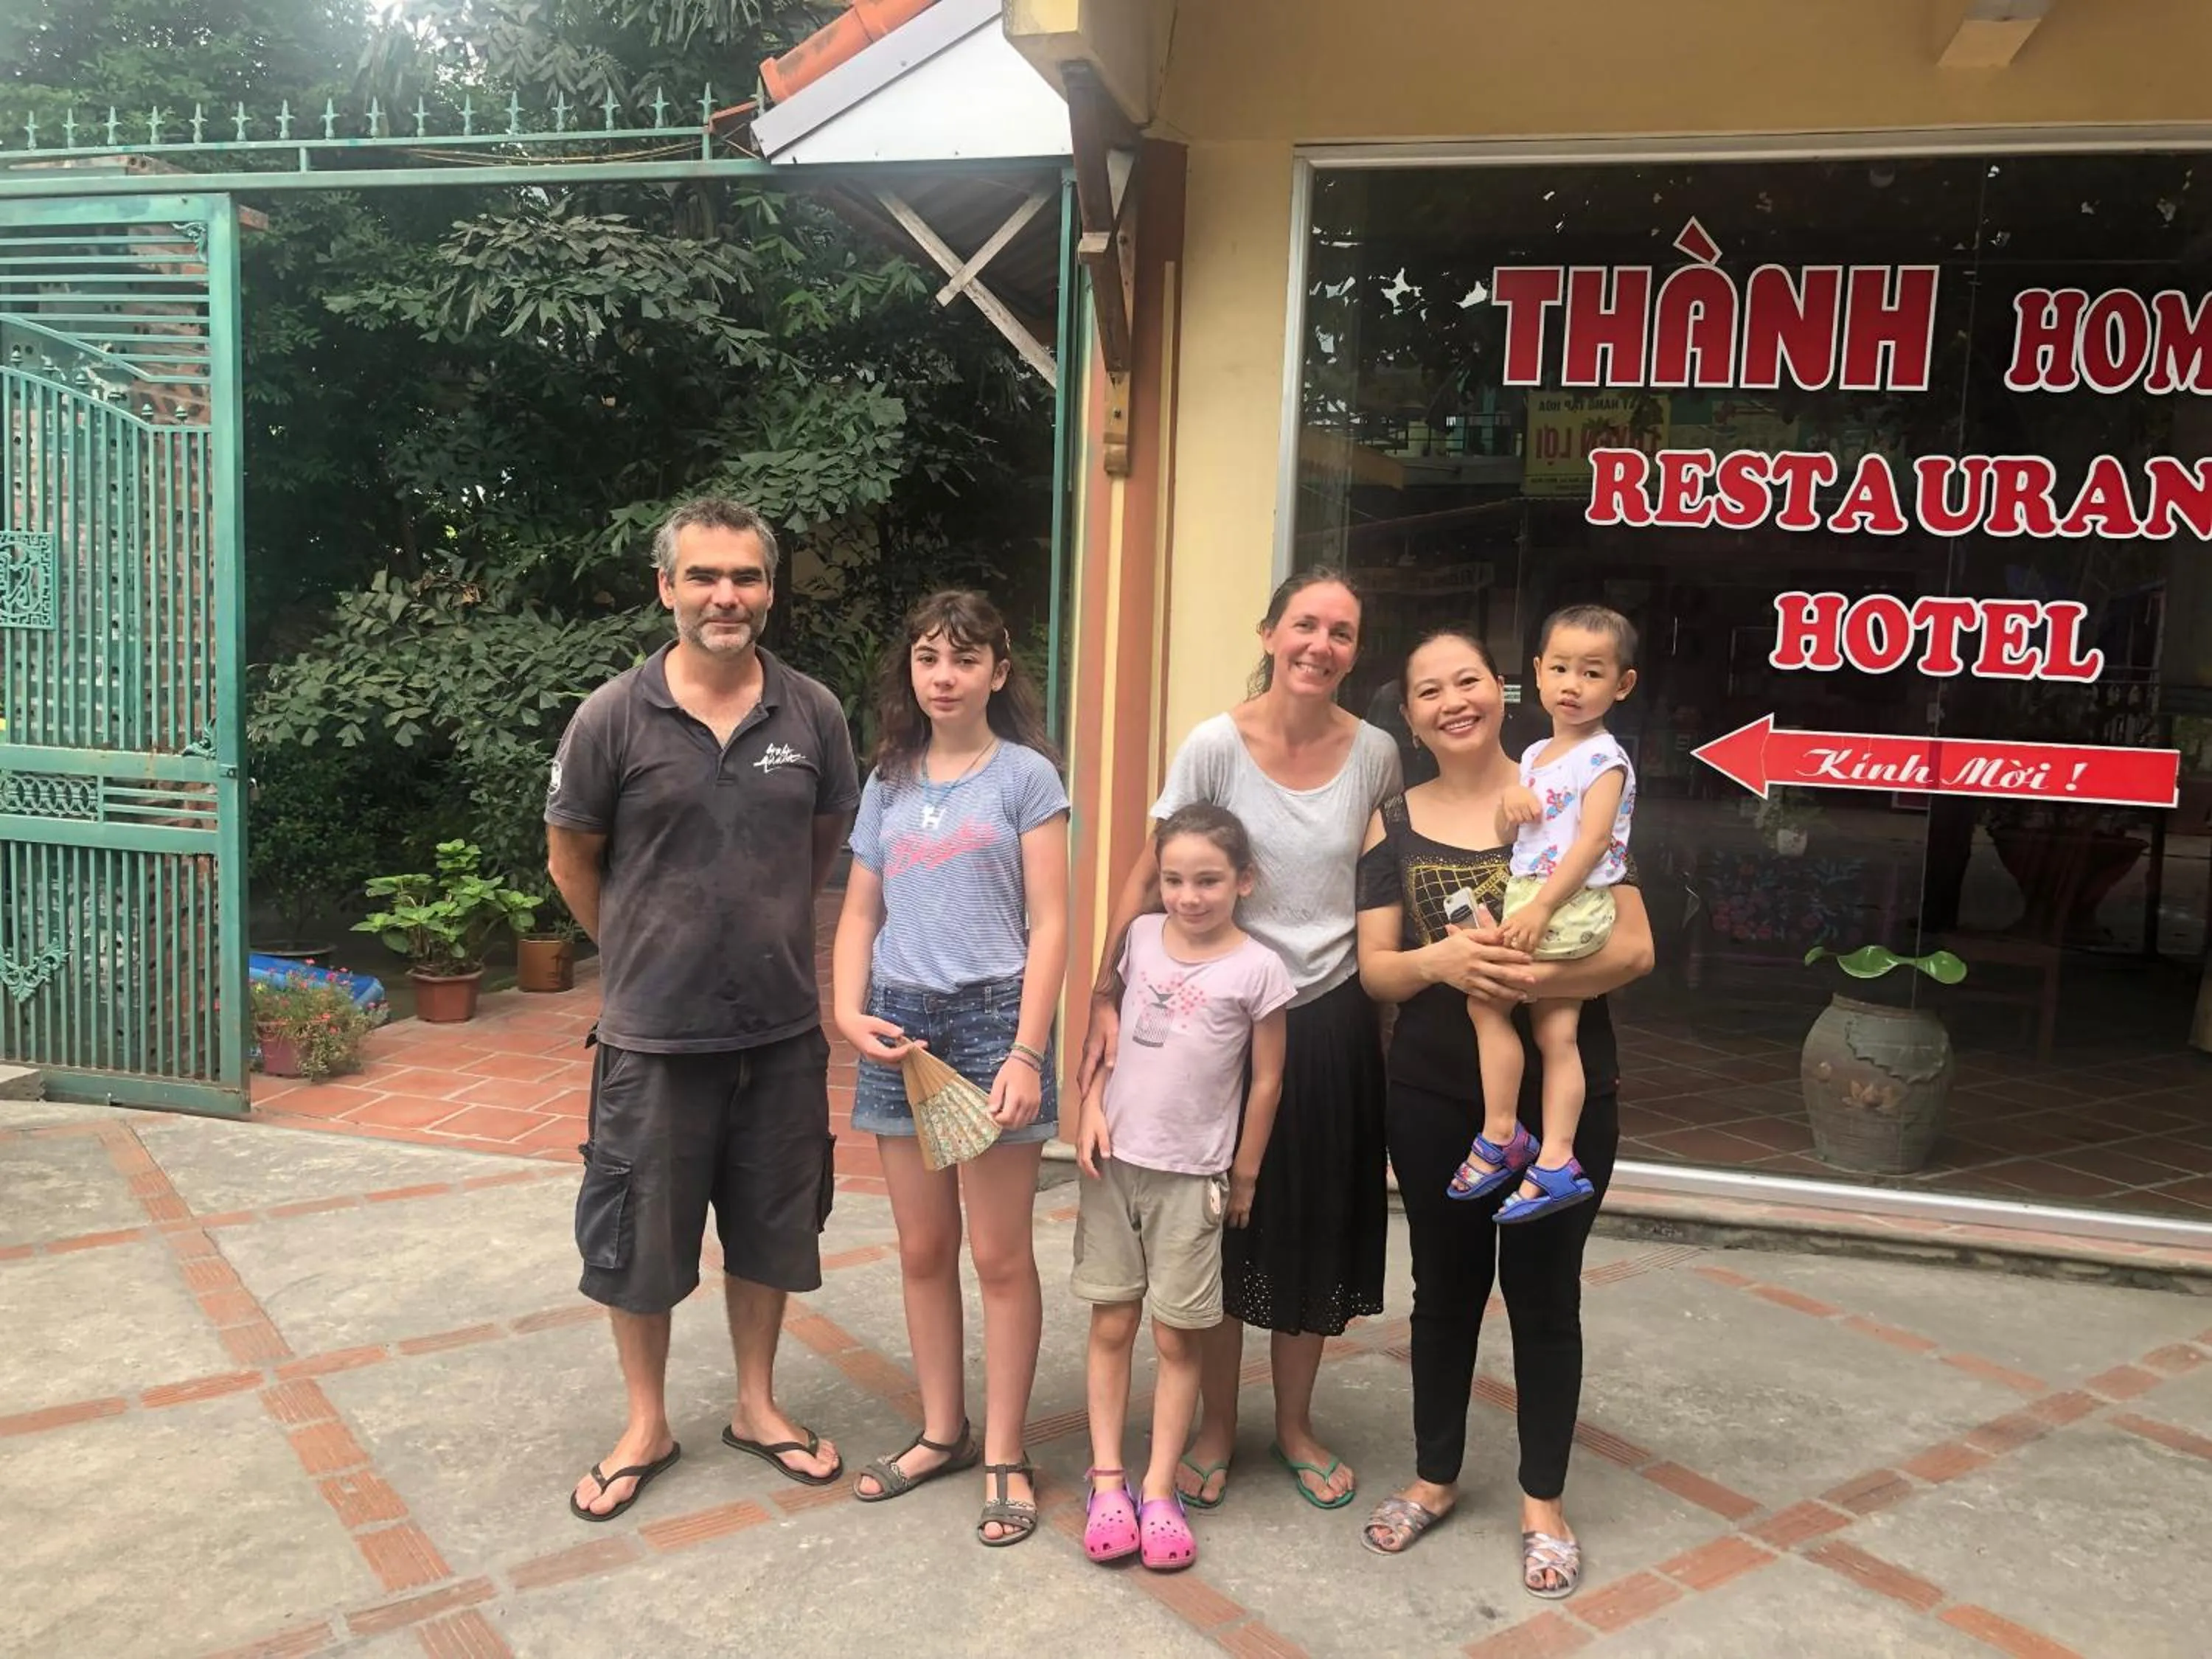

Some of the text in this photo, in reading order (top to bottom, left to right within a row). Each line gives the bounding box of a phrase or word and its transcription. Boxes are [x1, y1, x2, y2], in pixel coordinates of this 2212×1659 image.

[1492, 217, 1940, 392] THÀNH
[1585, 448, 2212, 540] RESTAURAN
[1770, 591, 2105, 682] HOTEL
